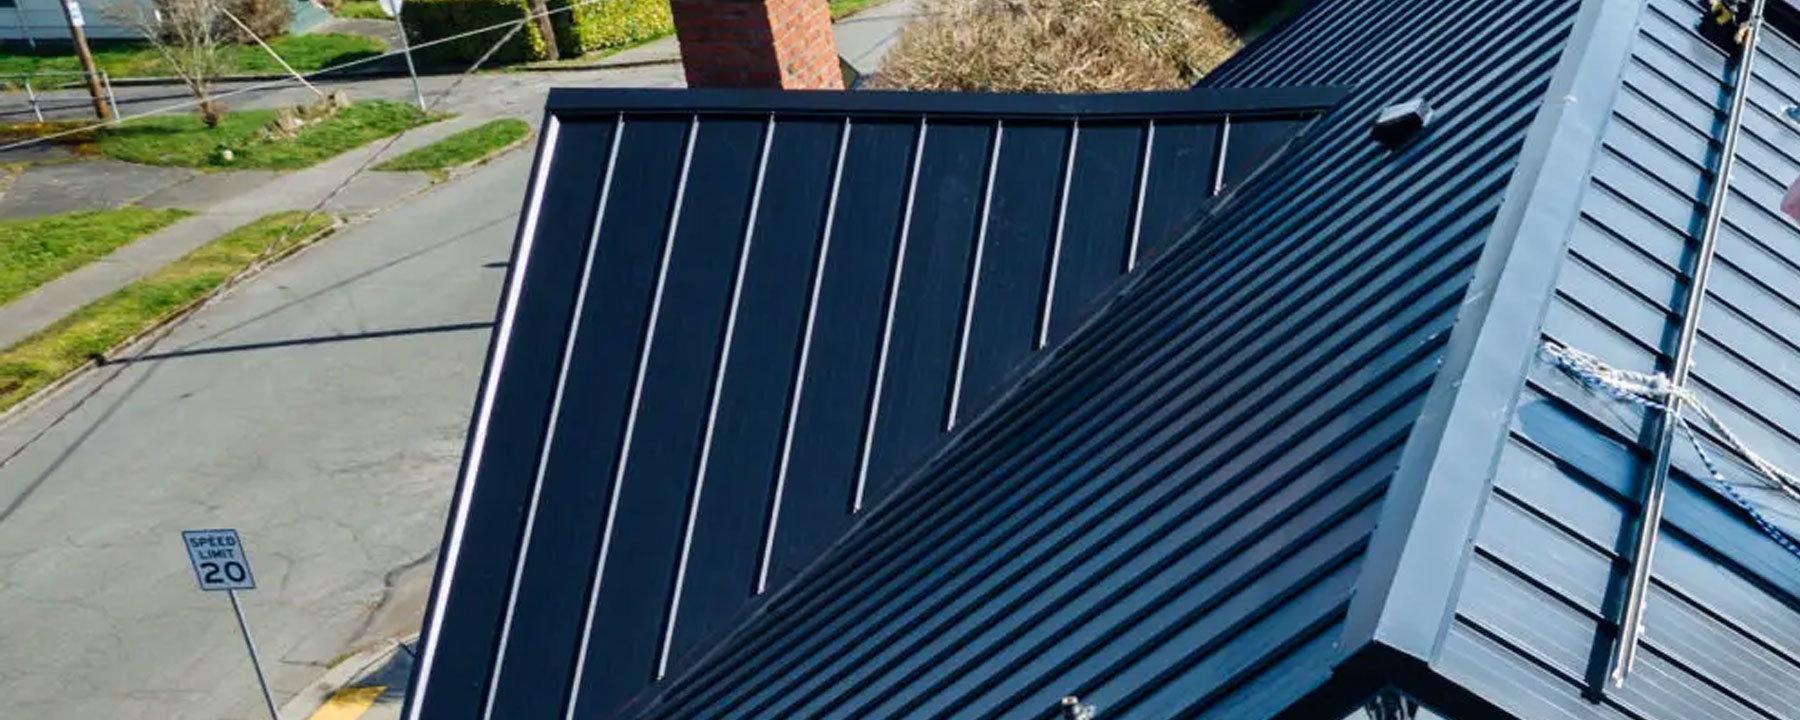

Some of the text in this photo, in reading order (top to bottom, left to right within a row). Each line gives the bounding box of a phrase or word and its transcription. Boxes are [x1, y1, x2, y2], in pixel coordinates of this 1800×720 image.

[190, 535, 235, 547] SPEED
[198, 549, 234, 559] LIMIT
[201, 561, 246, 583] 20
